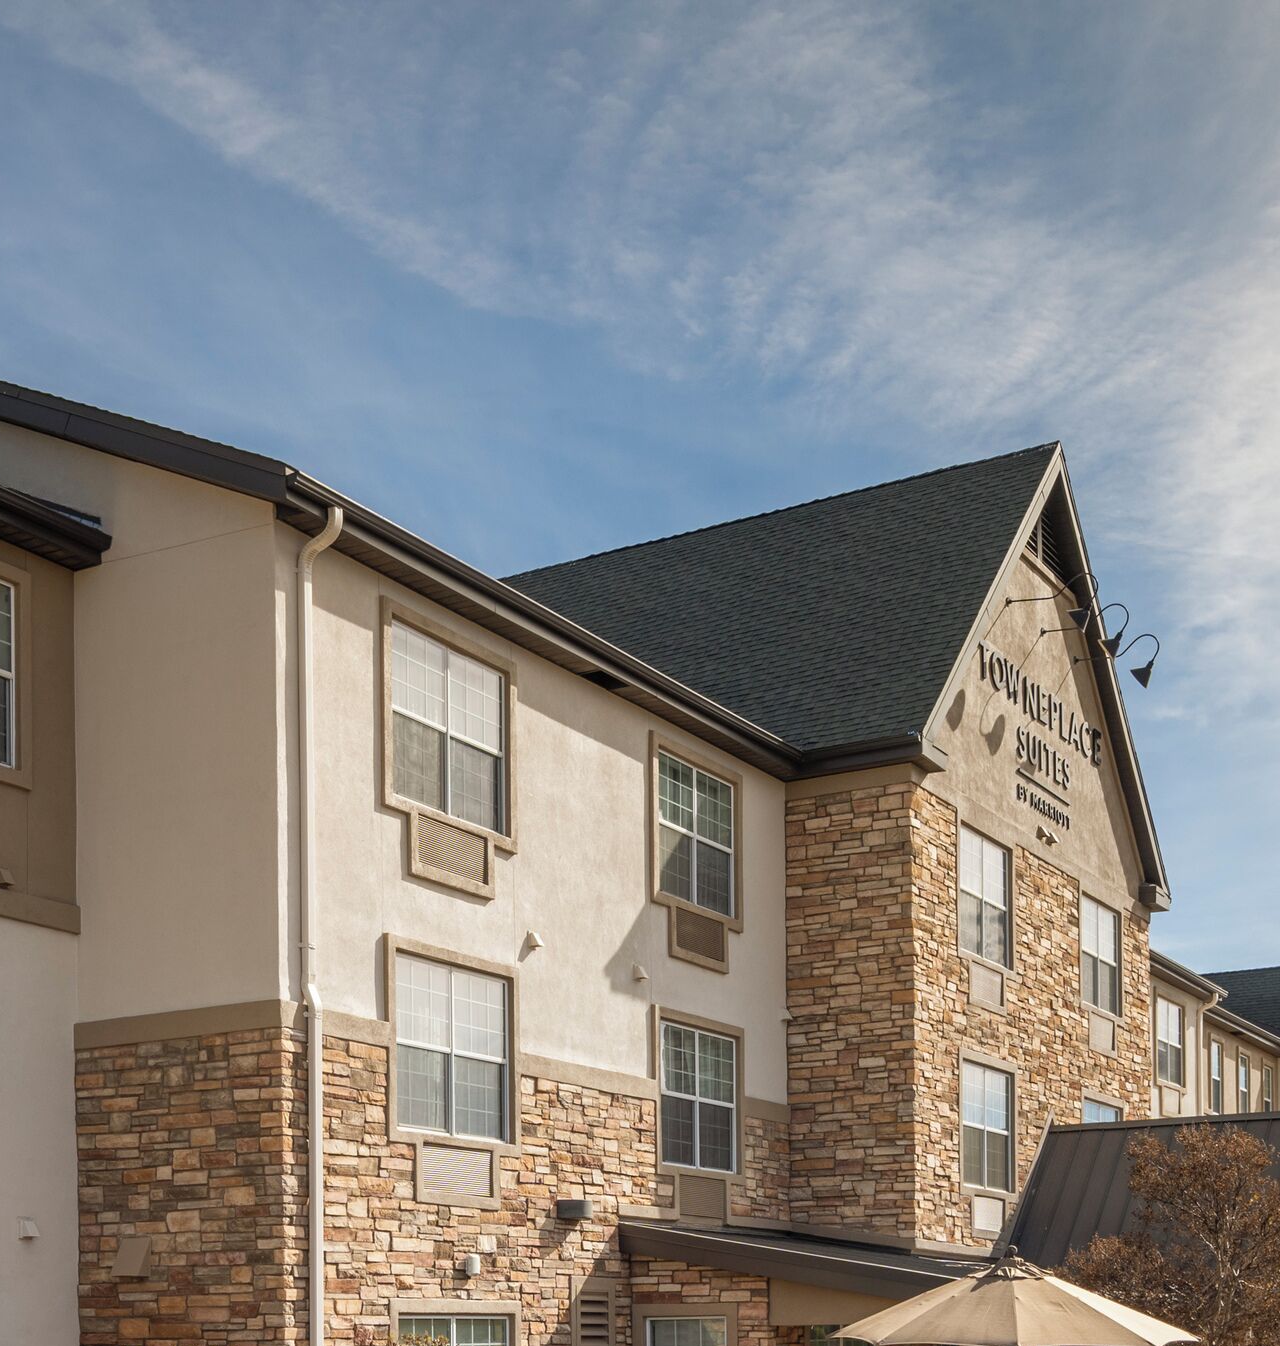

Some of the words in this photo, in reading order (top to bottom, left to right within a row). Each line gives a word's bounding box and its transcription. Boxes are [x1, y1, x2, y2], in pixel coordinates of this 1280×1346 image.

[978, 640, 1102, 767] TOWNEPLACE
[1016, 726, 1070, 790] SUITES
[1016, 783, 1029, 803] BY
[1030, 792, 1070, 830] MARRIOTT
